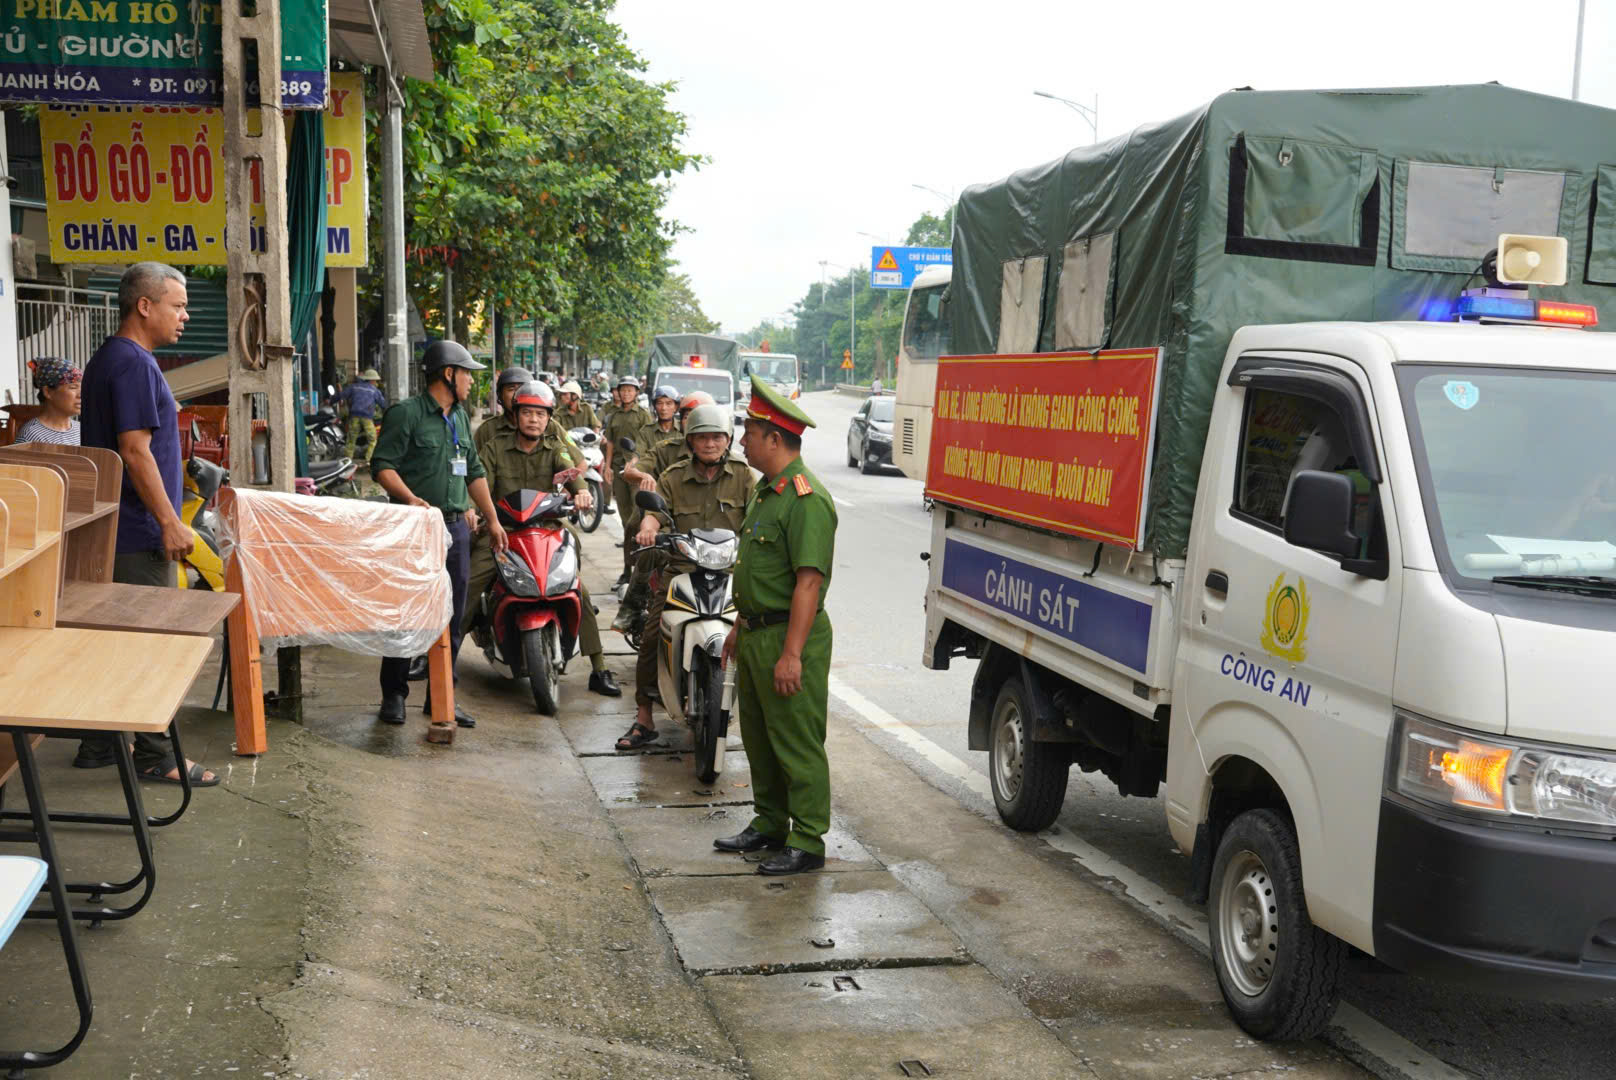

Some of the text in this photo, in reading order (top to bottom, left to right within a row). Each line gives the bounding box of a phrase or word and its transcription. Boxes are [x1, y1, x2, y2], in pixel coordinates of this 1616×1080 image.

[0, 26, 26, 53] Ủ
[0, 73, 48, 89] ANH
[57, 71, 100, 91] HÓA
[150, 78, 177, 93] ĐT:
[54, 122, 99, 203] ĐỒ
[63, 218, 138, 251] CHĂN
[164, 224, 198, 251] GA
[1007, 386, 1018, 426] LÀ
[1019, 387, 1050, 429] KHÔNG
[1050, 394, 1075, 431] GIAN
[1076, 387, 1106, 433] CÔNG
[1108, 387, 1139, 443] CỘNG,
[1000, 454, 1022, 490] KINH
[1055, 456, 1086, 502] BUÔN
[1084, 458, 1113, 507] BÁN!
[985, 560, 1080, 633] CẢNH SÁT
[1220, 651, 1311, 707] CÔNG AN
